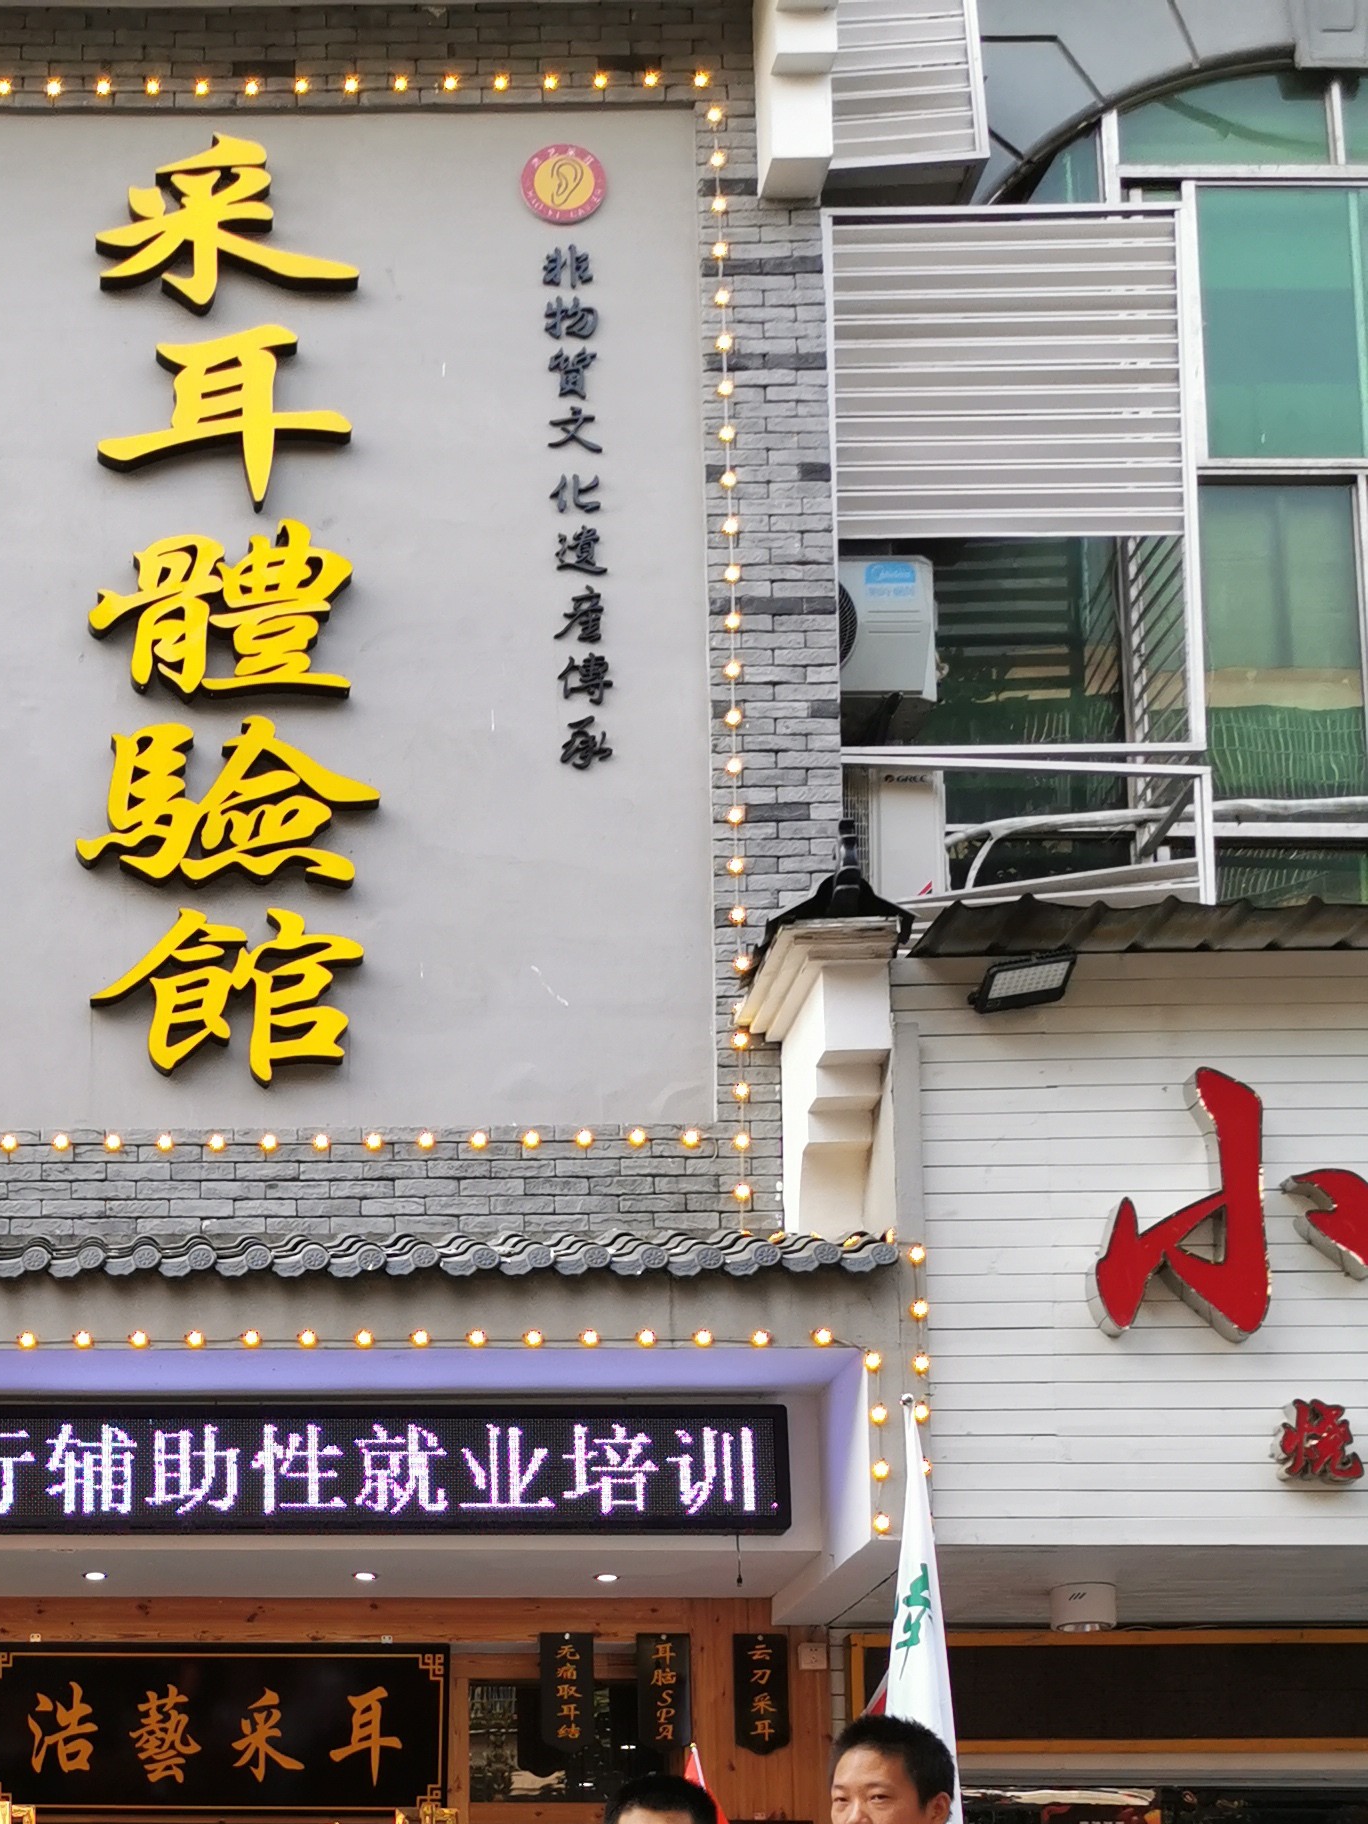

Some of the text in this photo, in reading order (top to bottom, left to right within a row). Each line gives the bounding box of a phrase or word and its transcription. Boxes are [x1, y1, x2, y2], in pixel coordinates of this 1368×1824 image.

[76, 133, 380, 1090] 采耳體驗館
[27, 1681, 404, 1786] 浩藝采耳
[747, 1644, 778, 1742] 云刀采耳
